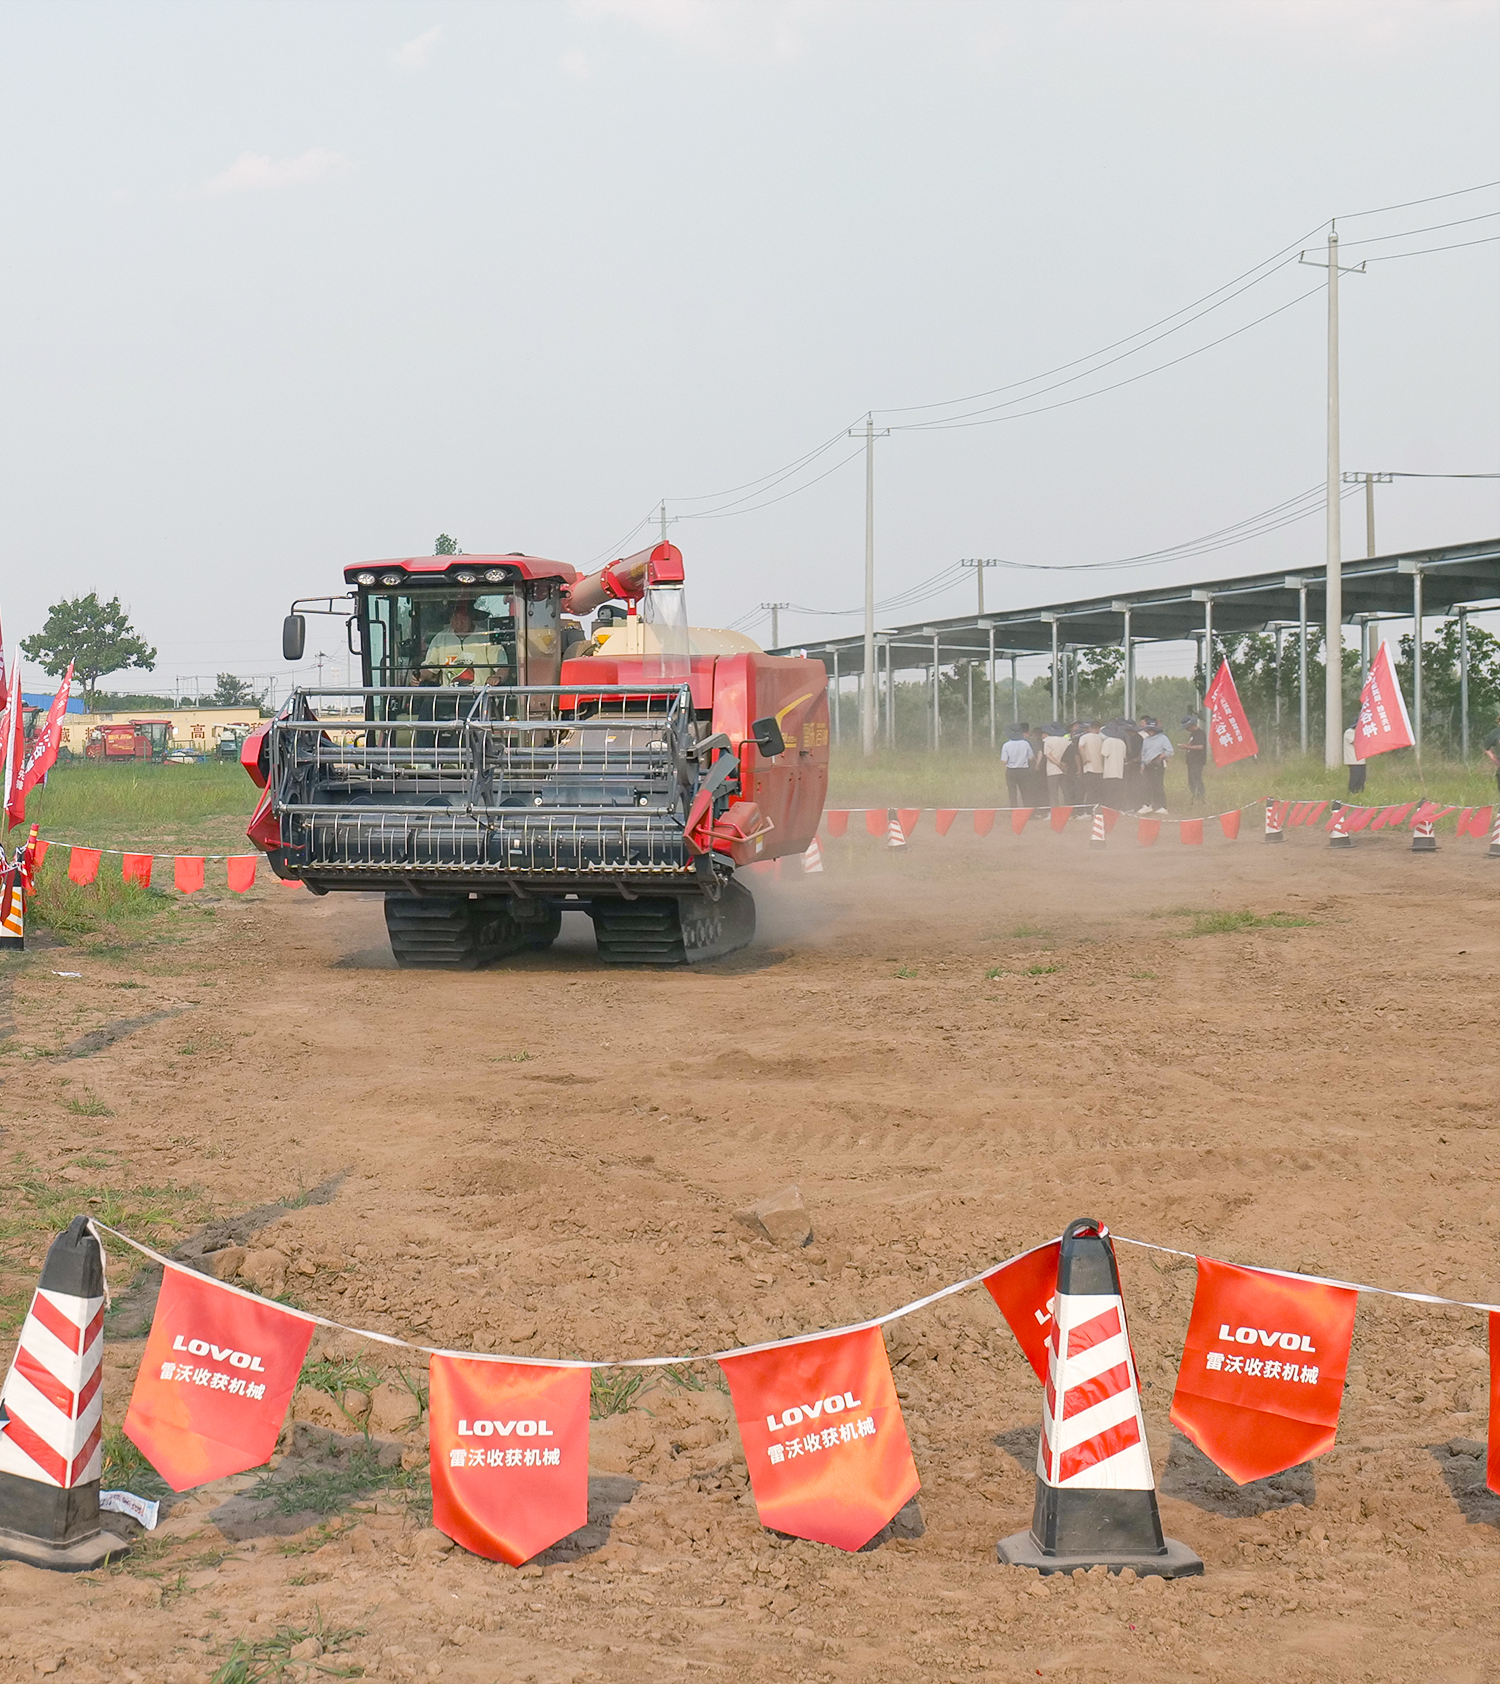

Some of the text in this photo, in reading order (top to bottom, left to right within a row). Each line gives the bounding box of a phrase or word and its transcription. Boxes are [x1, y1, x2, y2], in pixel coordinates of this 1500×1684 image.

[173, 1335, 265, 1372] LOVOL
[1219, 1324, 1316, 1353] LOVOL
[160, 1362, 266, 1400] 雷沃收获机械
[1206, 1352, 1319, 1385] 雷沃收获机械
[458, 1420, 554, 1437] LOVOL
[766, 1391, 861, 1432] LOVOL
[449, 1449, 561, 1468] 雷沃收获机械
[767, 1417, 876, 1465] 雷沃收获机械
